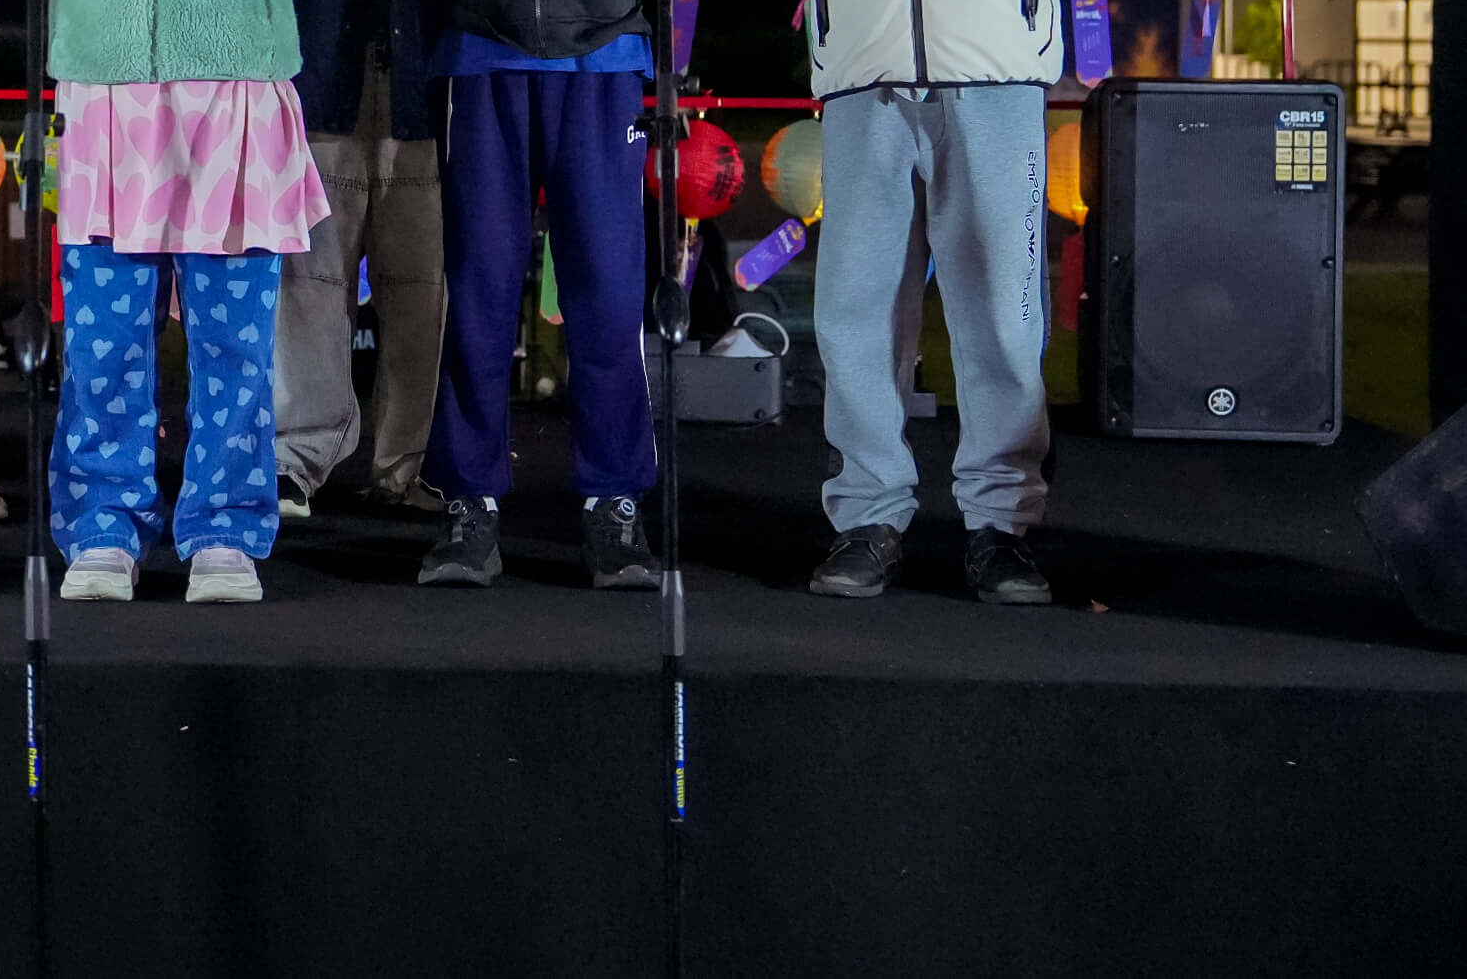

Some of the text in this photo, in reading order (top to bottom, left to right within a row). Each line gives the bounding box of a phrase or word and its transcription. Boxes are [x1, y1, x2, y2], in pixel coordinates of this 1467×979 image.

[1279, 110, 1325, 123] CBR15
[1025, 151, 1041, 232] EMPOIO
[352, 328, 376, 351] HA
